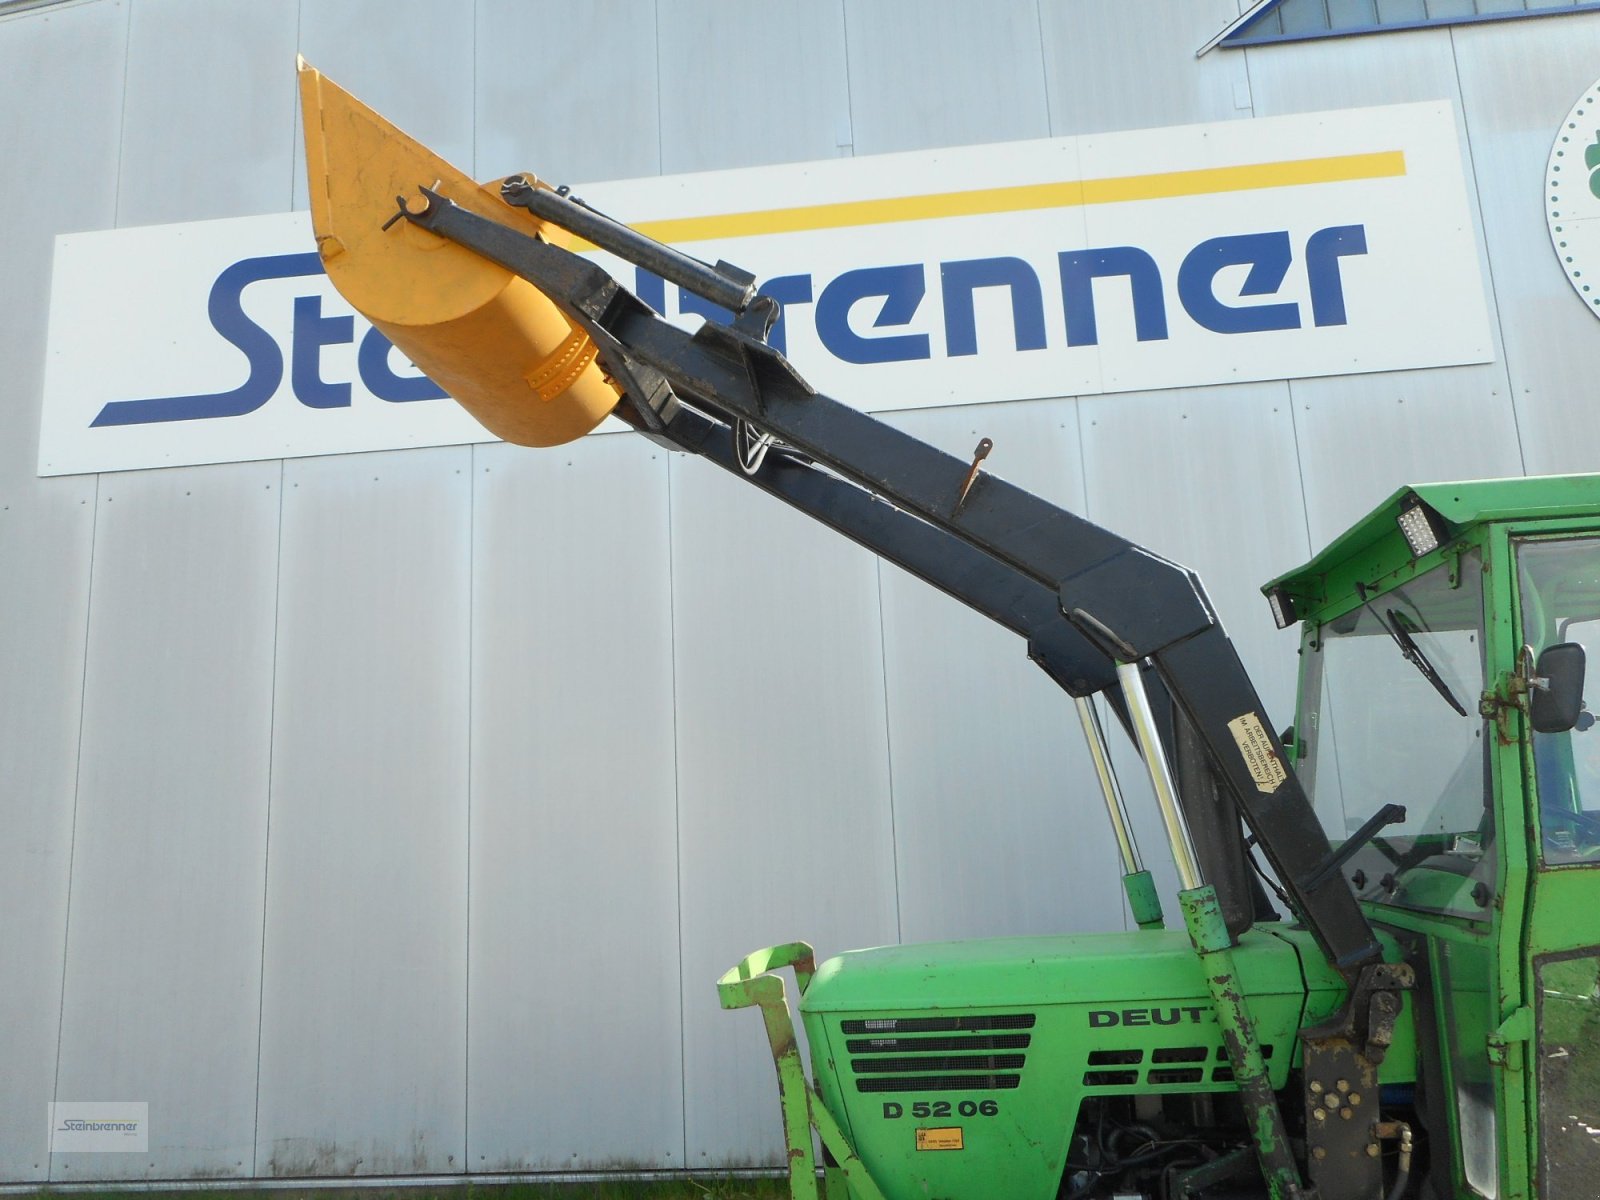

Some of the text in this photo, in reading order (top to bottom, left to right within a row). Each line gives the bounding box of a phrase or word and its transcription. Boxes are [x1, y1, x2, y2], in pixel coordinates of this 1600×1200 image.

[88, 224, 1368, 428] Sterenner
[1253, 725, 1265, 739] DER
[1240, 717, 1276, 786] IM ARBEITSBEREICH
[1242, 741, 1264, 780] VERBOTEN!
[1088, 1005, 1218, 1028] DEUT
[883, 1102, 904, 1119] D
